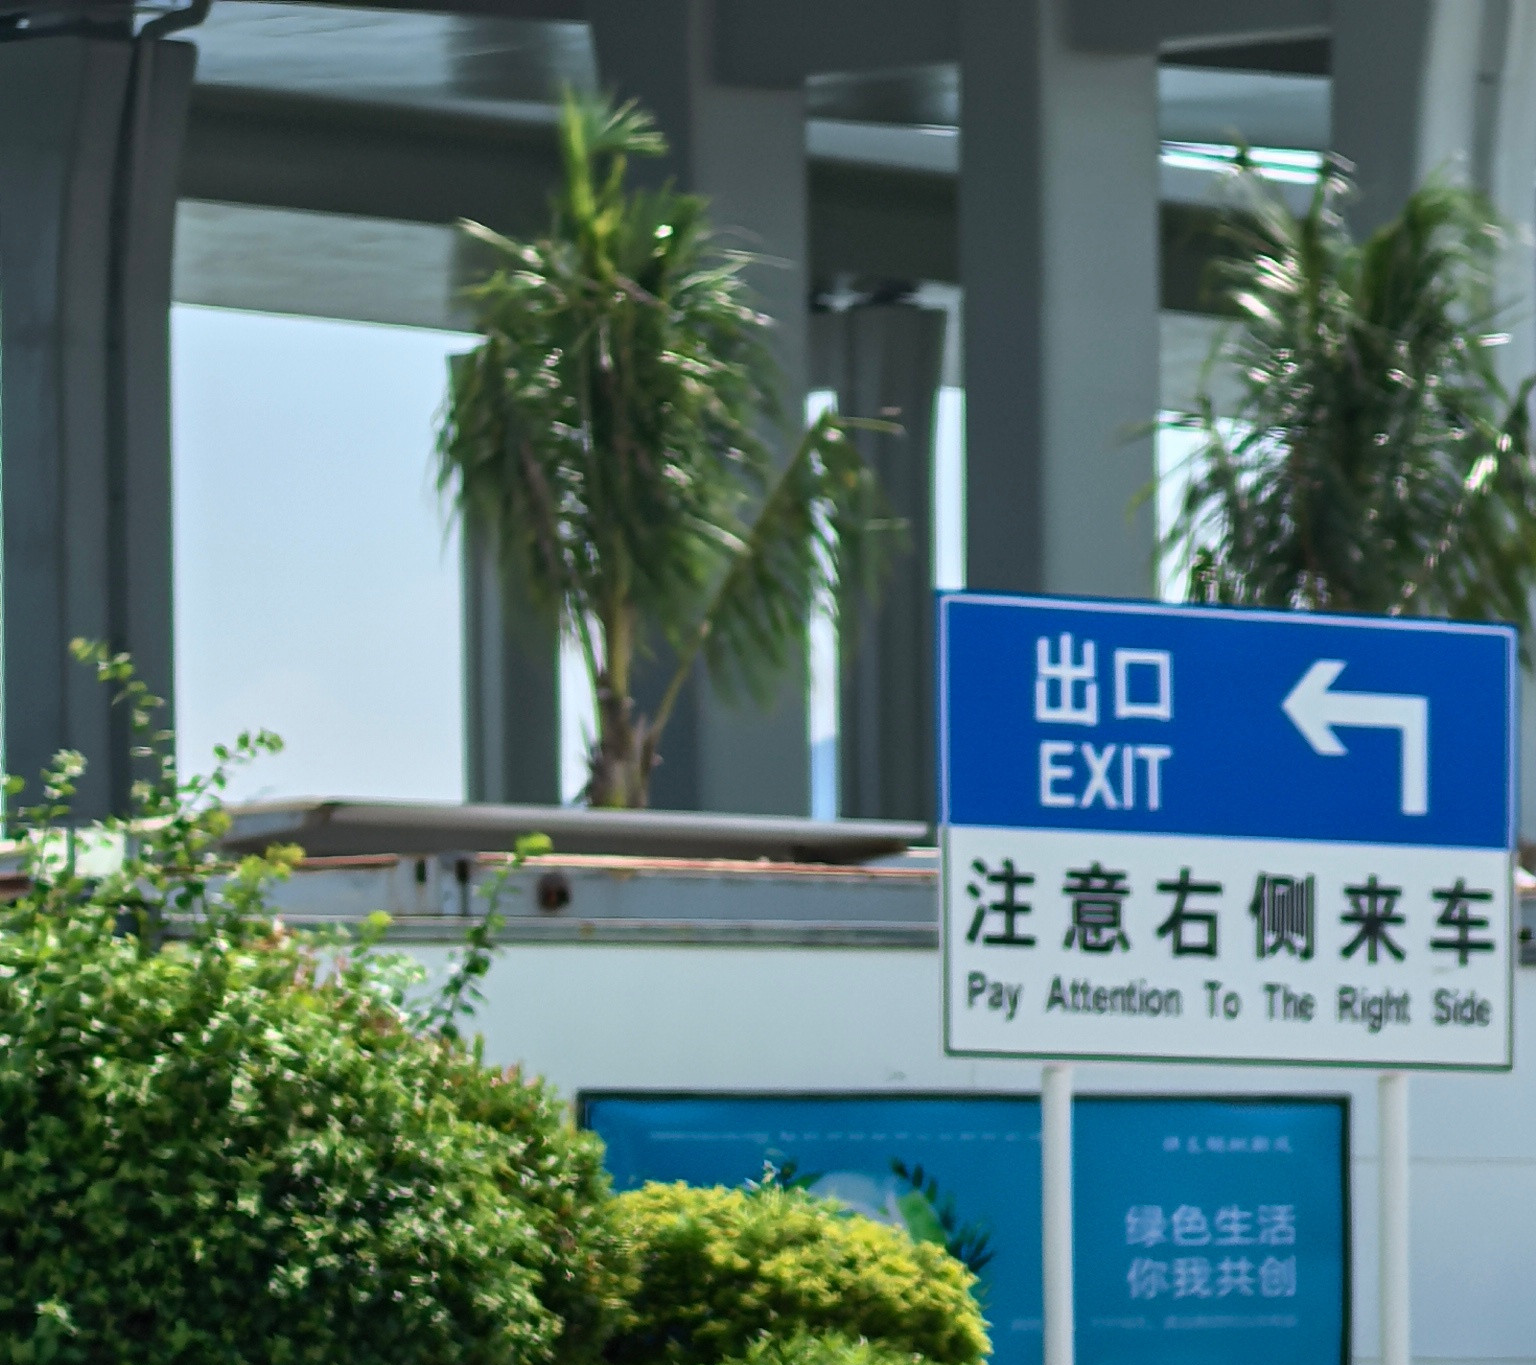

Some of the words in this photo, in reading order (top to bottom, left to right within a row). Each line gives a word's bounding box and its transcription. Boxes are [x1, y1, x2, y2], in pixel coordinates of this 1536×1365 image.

[1035, 633, 1173, 725] 出口
[1040, 741, 1172, 811] EXIT
[966, 858, 1495, 966] 注意右侧来车
[967, 972, 1022, 1021] Pay
[1046, 975, 1182, 1018] Attention
[1203, 980, 1242, 1020] To
[1263, 982, 1315, 1022] The
[1337, 985, 1412, 1032] Right
[1433, 989, 1491, 1028] Side
[1125, 1204, 1296, 1247] 绿色生活
[1126, 1256, 1297, 1299] 你我共创
